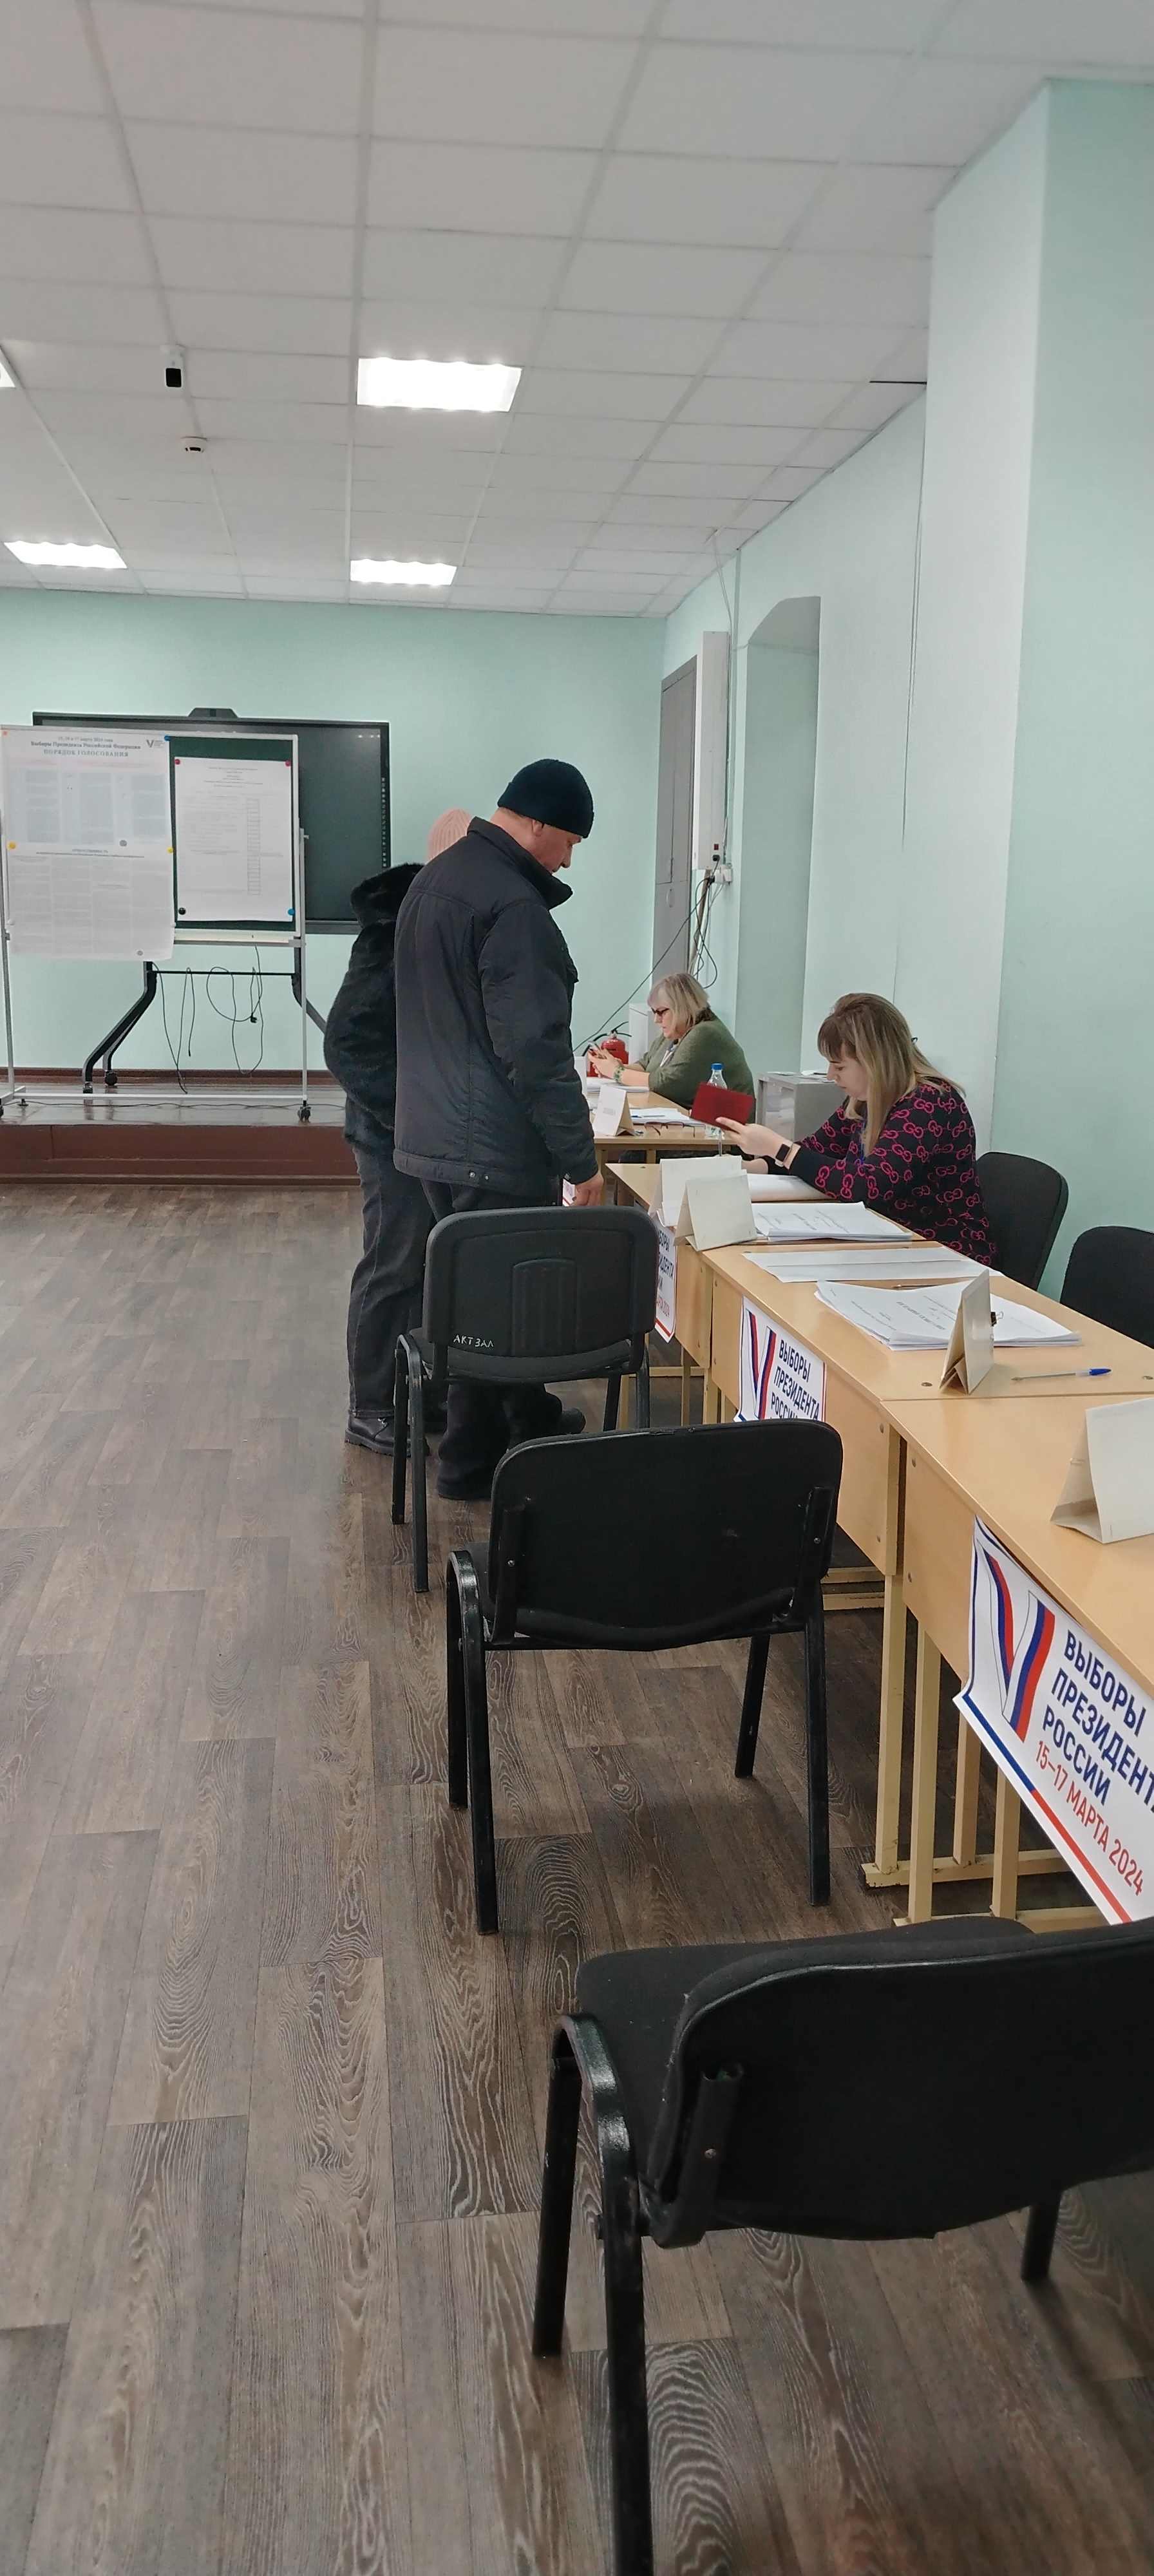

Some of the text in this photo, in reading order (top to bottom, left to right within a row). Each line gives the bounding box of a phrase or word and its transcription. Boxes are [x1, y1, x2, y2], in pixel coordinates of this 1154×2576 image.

[658, 1229, 670, 1252] БОРЫ
[453, 1334, 494, 1348] АКТ ЗАЛ
[779, 1339, 811, 1383] ВЫБОРЫ
[774, 1365, 820, 1420] ПРЕЗИДЕНТА
[1064, 1629, 1146, 1738] ВЫБОРЫ
[1043, 1704, 1111, 1806] РОССИИ
[1052, 1667, 1154, 1814] ПРЕЗИДЕНТ
[1066, 1781, 1110, 1853] МАРТА
[1109, 1839, 1144, 1896] 2024
